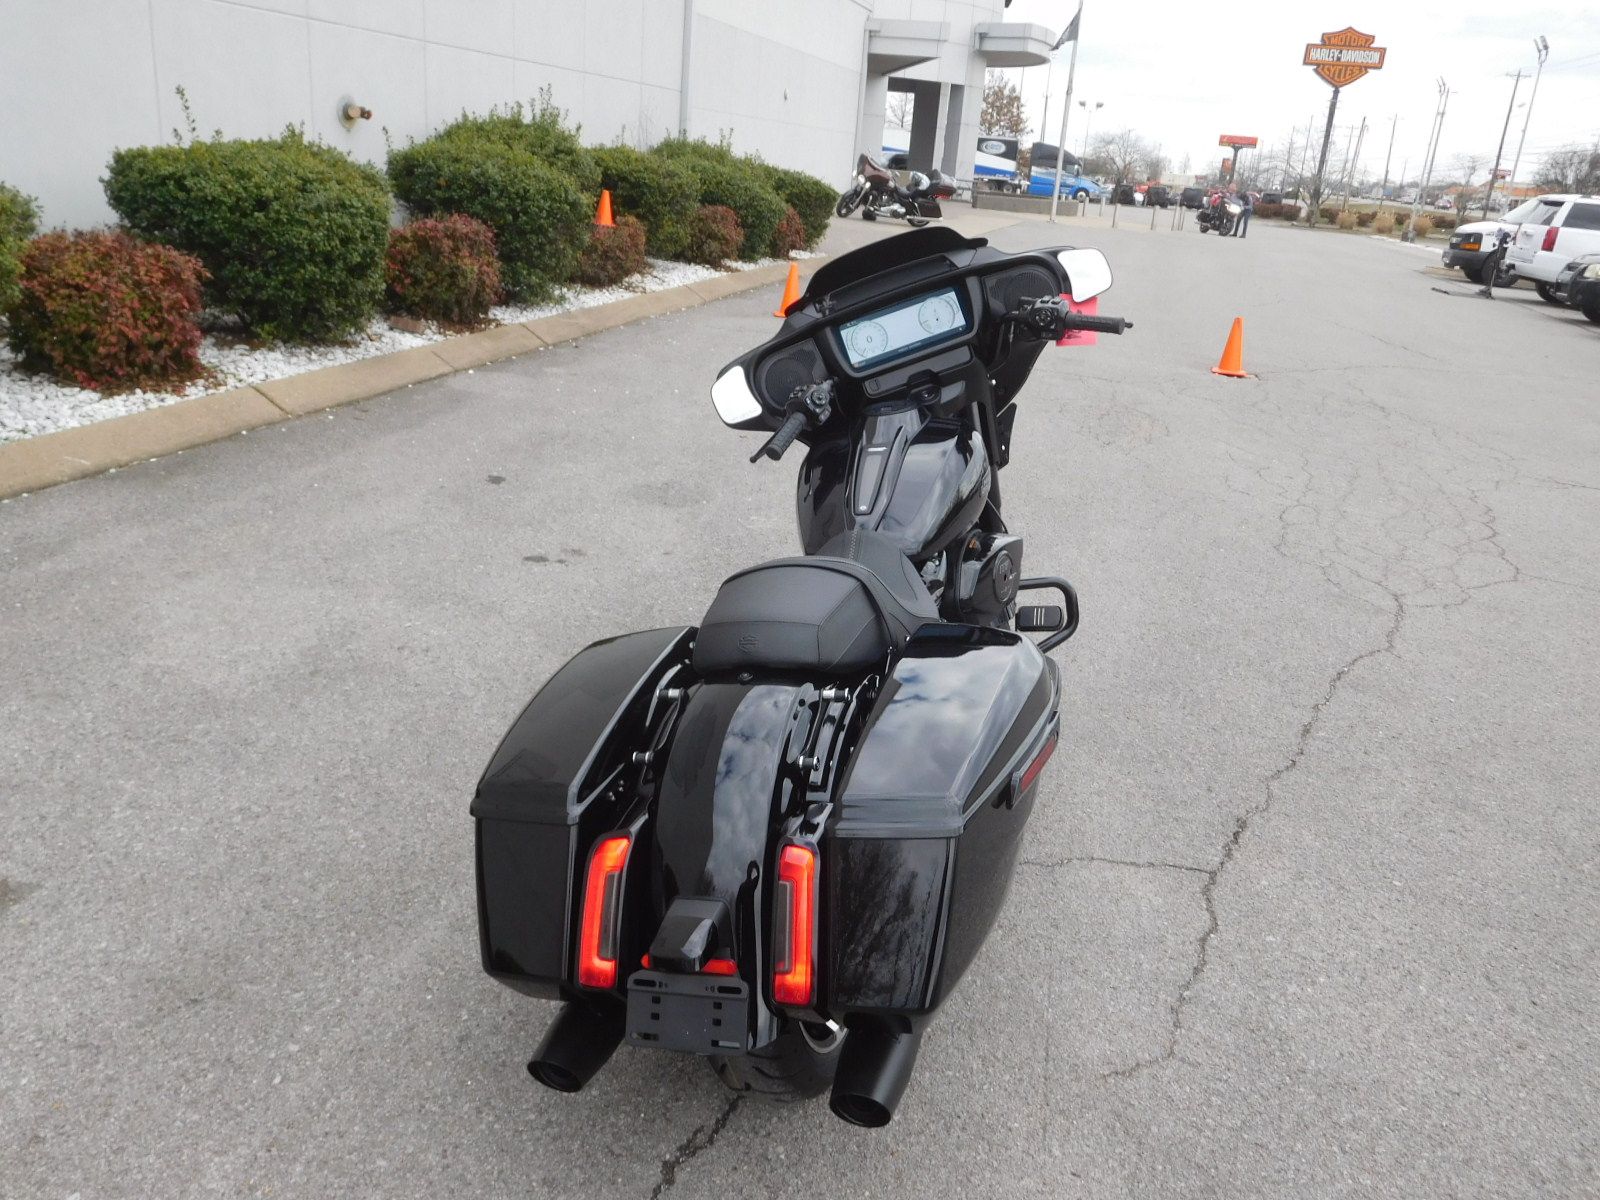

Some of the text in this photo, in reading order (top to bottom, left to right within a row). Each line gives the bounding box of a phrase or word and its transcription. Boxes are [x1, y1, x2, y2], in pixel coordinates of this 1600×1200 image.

[1329, 35, 1366, 47] MOTOR
[1310, 47, 1380, 64] HARLEY-DAVIDSON
[1323, 65, 1360, 81] CYCLES
